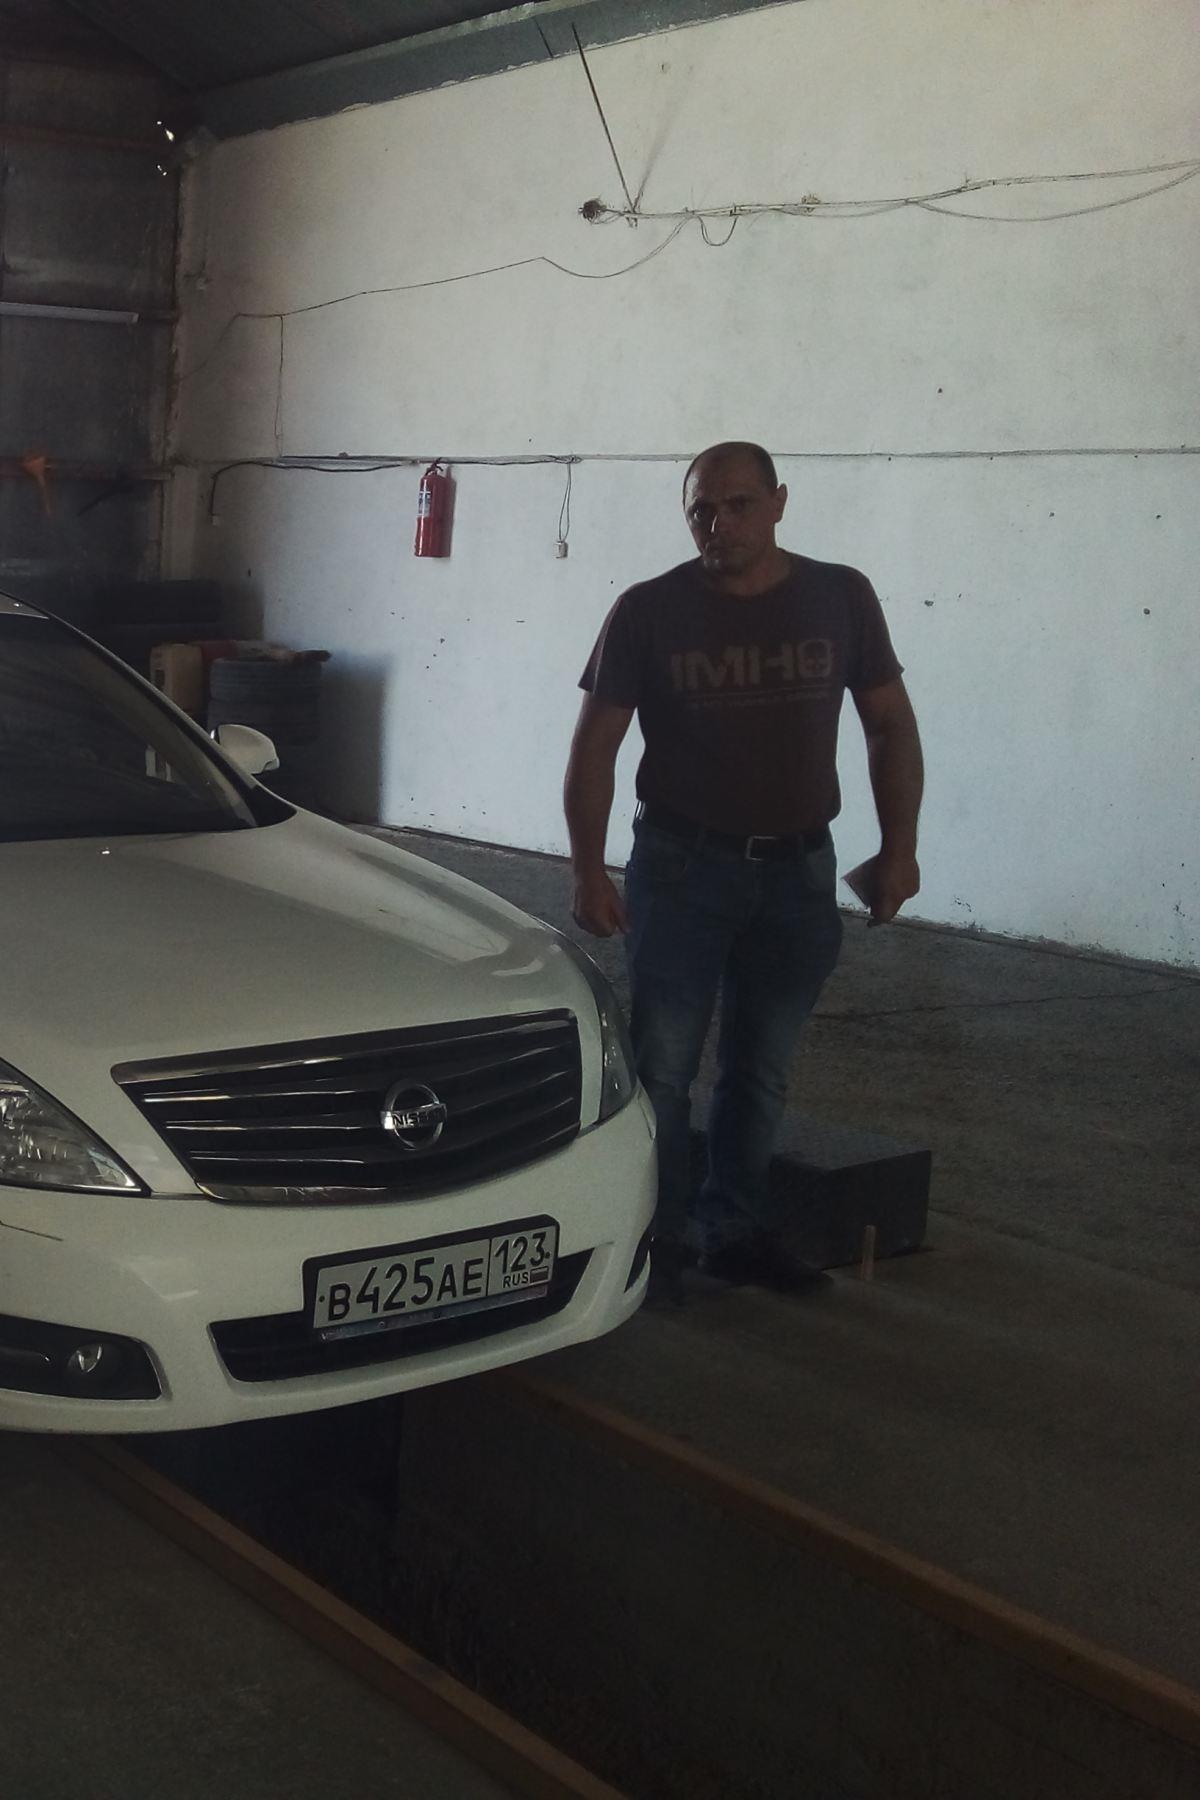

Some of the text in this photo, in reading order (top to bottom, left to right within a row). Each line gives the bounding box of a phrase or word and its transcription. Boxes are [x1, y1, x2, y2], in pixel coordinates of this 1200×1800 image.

[327, 1231, 548, 1321] B425AE 123
[502, 1270, 529, 1289] RUS
